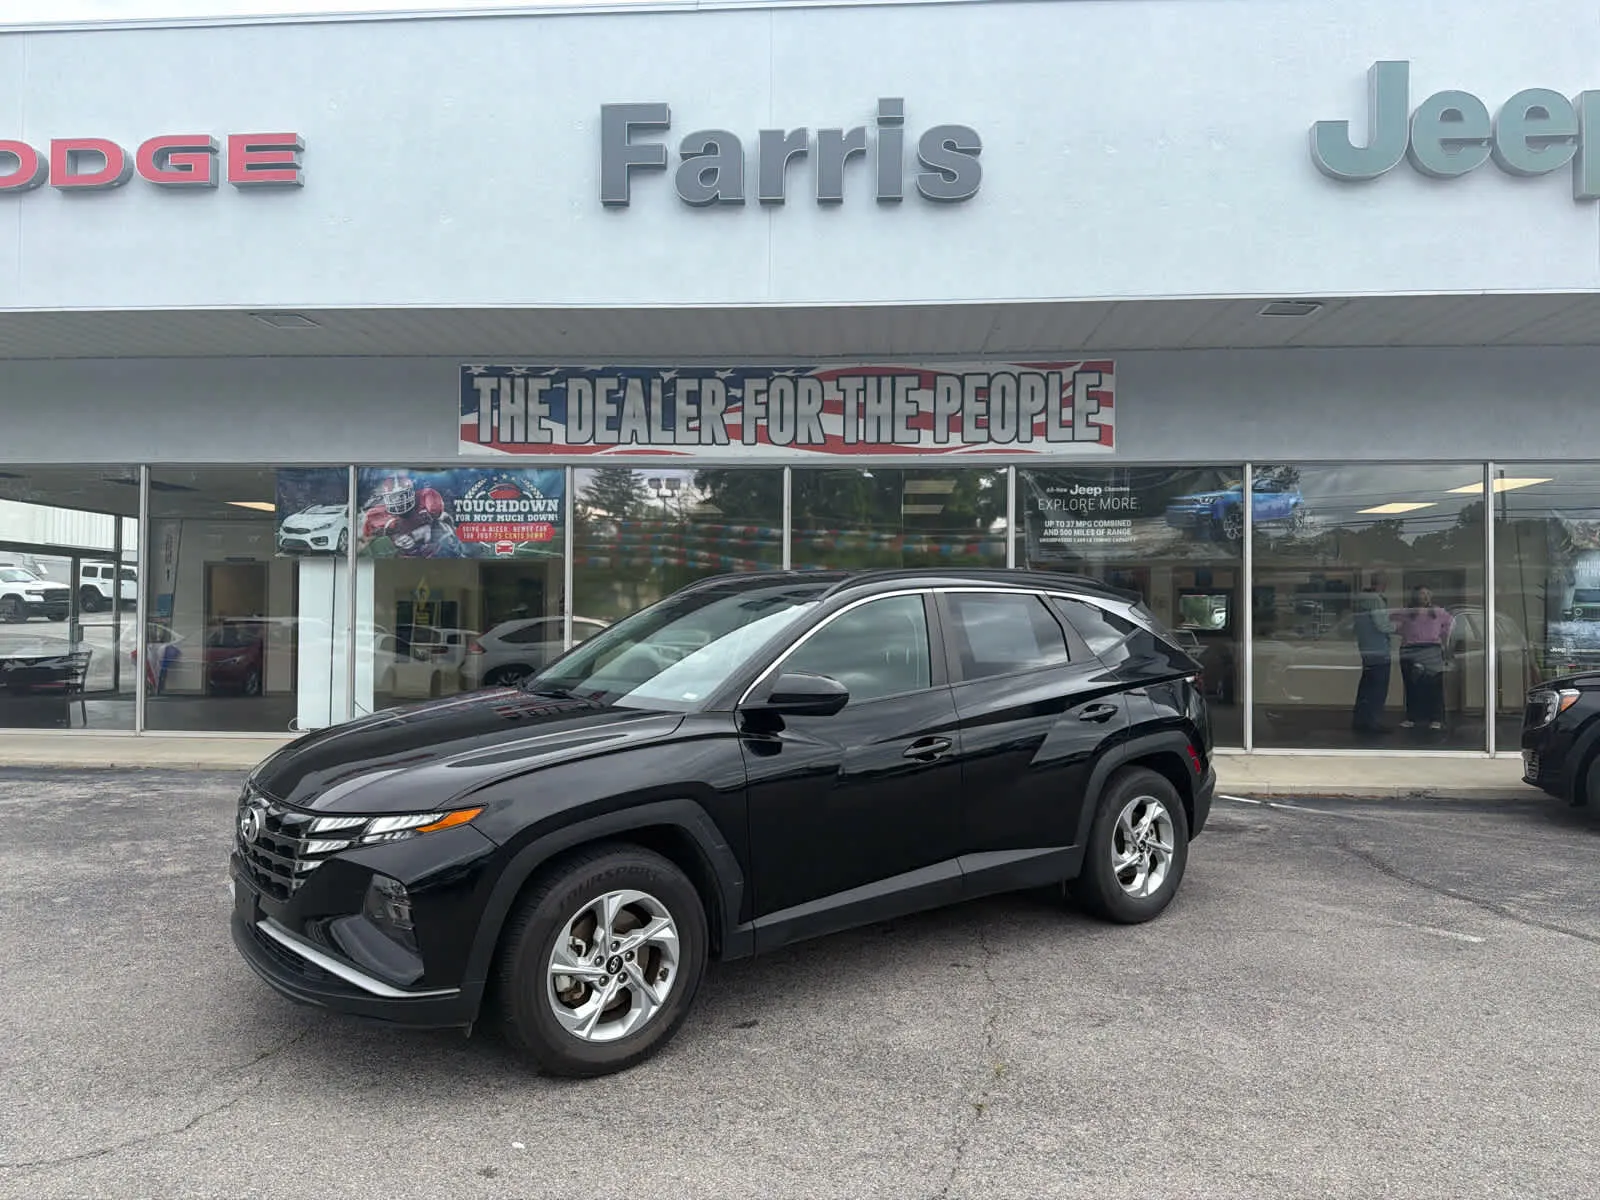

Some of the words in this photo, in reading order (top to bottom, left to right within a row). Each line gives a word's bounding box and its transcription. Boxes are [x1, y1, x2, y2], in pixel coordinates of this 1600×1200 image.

[600, 97, 984, 206] Farris
[472, 375, 553, 444] THE
[564, 375, 730, 445] DEALER
[742, 374, 825, 445] FOR
[837, 374, 921, 444] THE
[933, 370, 1102, 444] PEOPLE
[1070, 484, 1102, 496] Jeep
[454, 499, 559, 512] TOUCHDOWN
[1038, 498, 1096, 511] EXPLORE
[1099, 497, 1138, 510] MORE
[455, 514, 471, 522] FOR
[473, 514, 493, 522] NOT
[527, 513, 559, 521] DOWN!
[1044, 520, 1055, 528] UP
[1056, 520, 1065, 528] TO
[1075, 520, 1093, 528] MPG
[1093, 519, 1132, 527] COMBINED
[1043, 528, 1059, 536] AND
[1073, 528, 1095, 536] MILES
[1096, 528, 1106, 536] OF
[1106, 527, 1132, 536] RANGE
